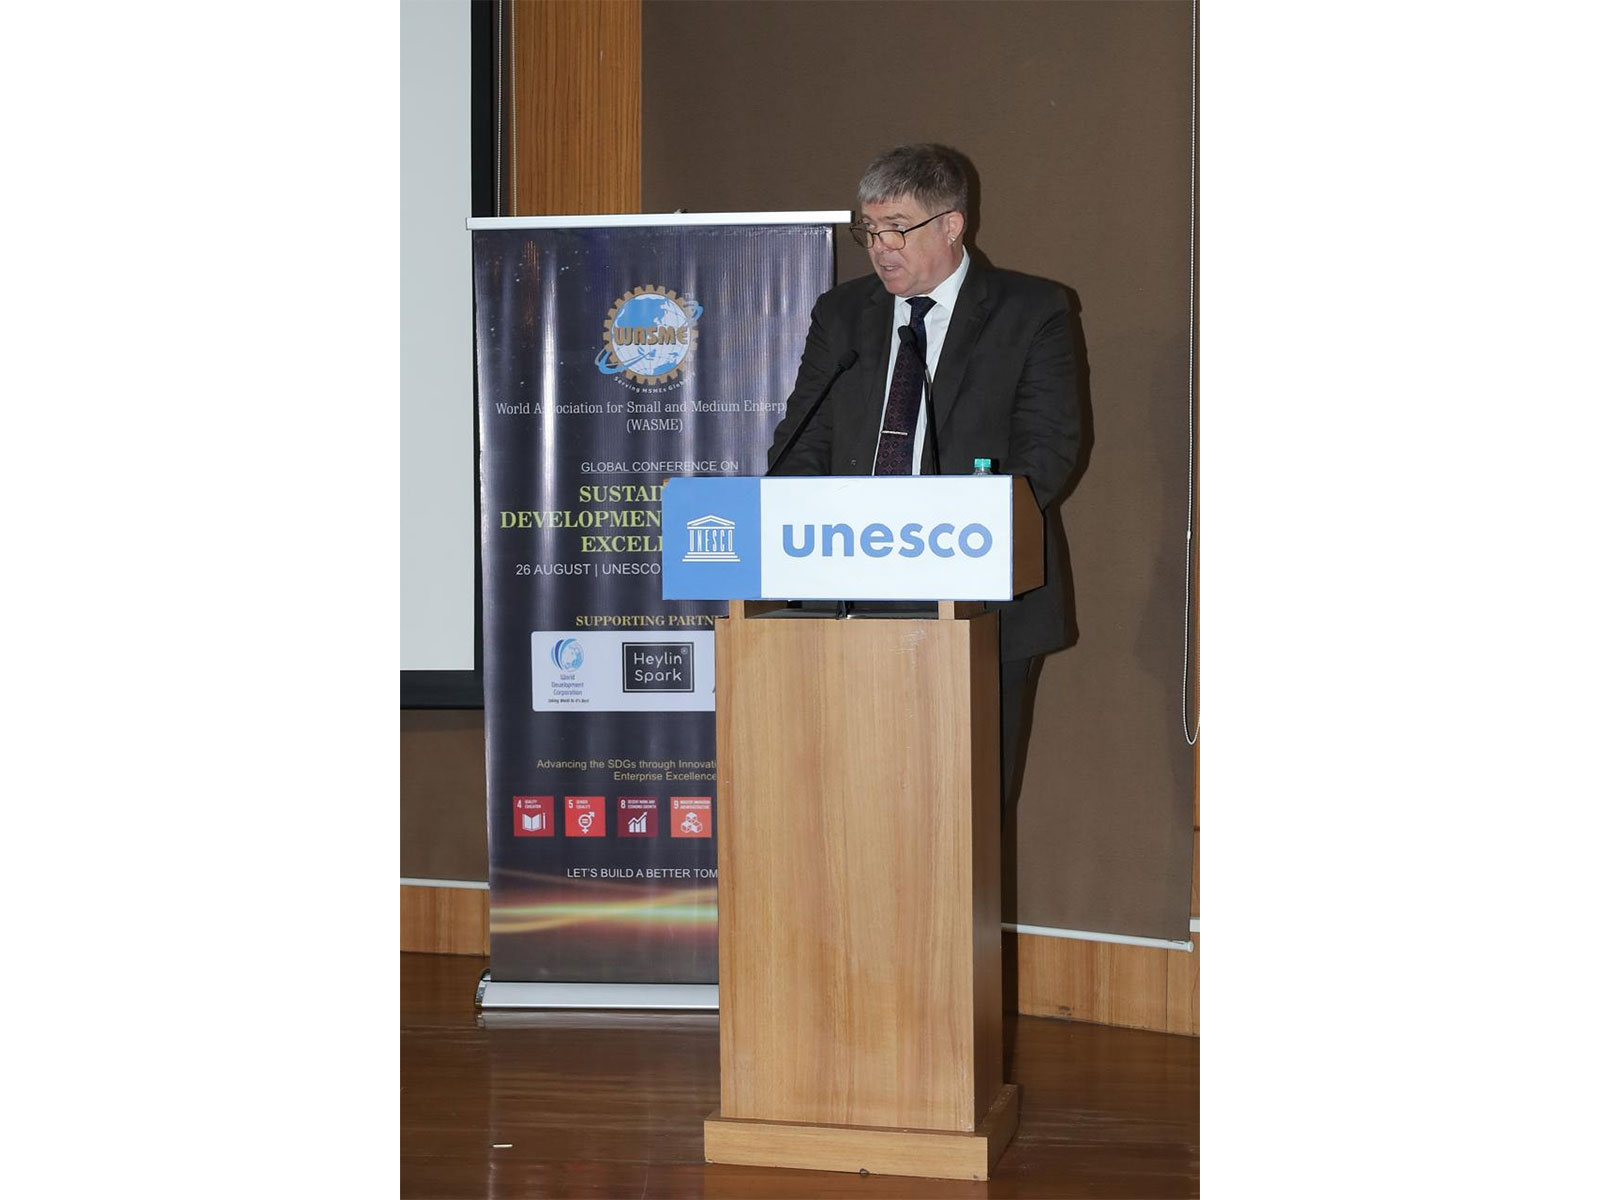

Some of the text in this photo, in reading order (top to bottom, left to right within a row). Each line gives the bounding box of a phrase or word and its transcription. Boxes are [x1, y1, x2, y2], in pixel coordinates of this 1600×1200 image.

[614, 326, 688, 346] WASME
[495, 400, 786, 415] World Aociation for Small and Medium Enterp
[626, 418, 683, 433] (WASME)
[581, 461, 738, 472] GLOBAL CONFERENCE ON
[500, 510, 662, 529] DEVELOPMEN
[689, 530, 733, 552] UNESCO
[782, 522, 993, 559] unesco
[515, 564, 531, 577] 26
[534, 564, 591, 577] AUGUST
[602, 563, 661, 576] UNESCO
[576, 614, 715, 627] SUPPORTING PARTN
[634, 652, 682, 669] Heylin
[634, 669, 682, 684] Spark
[537, 759, 717, 771] Advancing the SDGs through Innovati
[614, 771, 718, 783] Enterprise Excellence
[516, 800, 522, 809] 4
[568, 800, 574, 809] 5
[620, 799, 626, 809] 8
[567, 868, 718, 879] LET'S BUILD A BETTER TOM
